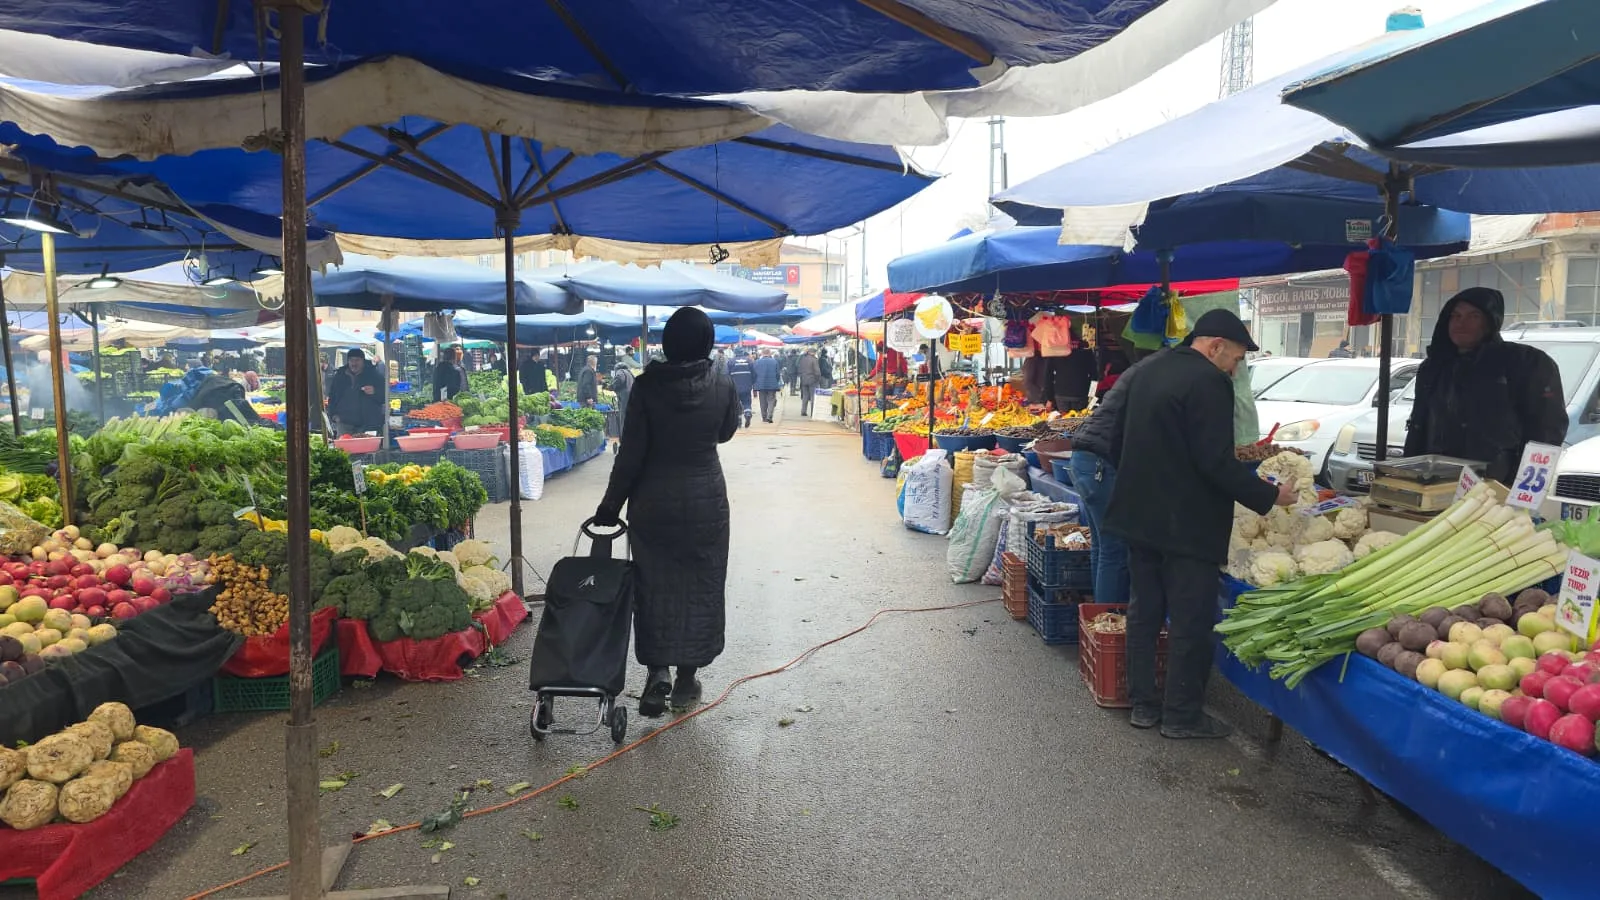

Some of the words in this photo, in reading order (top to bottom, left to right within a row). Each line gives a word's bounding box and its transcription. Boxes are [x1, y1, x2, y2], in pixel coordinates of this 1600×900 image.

[1517, 465, 1548, 493] 25
[1570, 506, 1582, 520] 16
[1570, 565, 1590, 580] VEZİR
[1567, 578, 1586, 592] TURP
